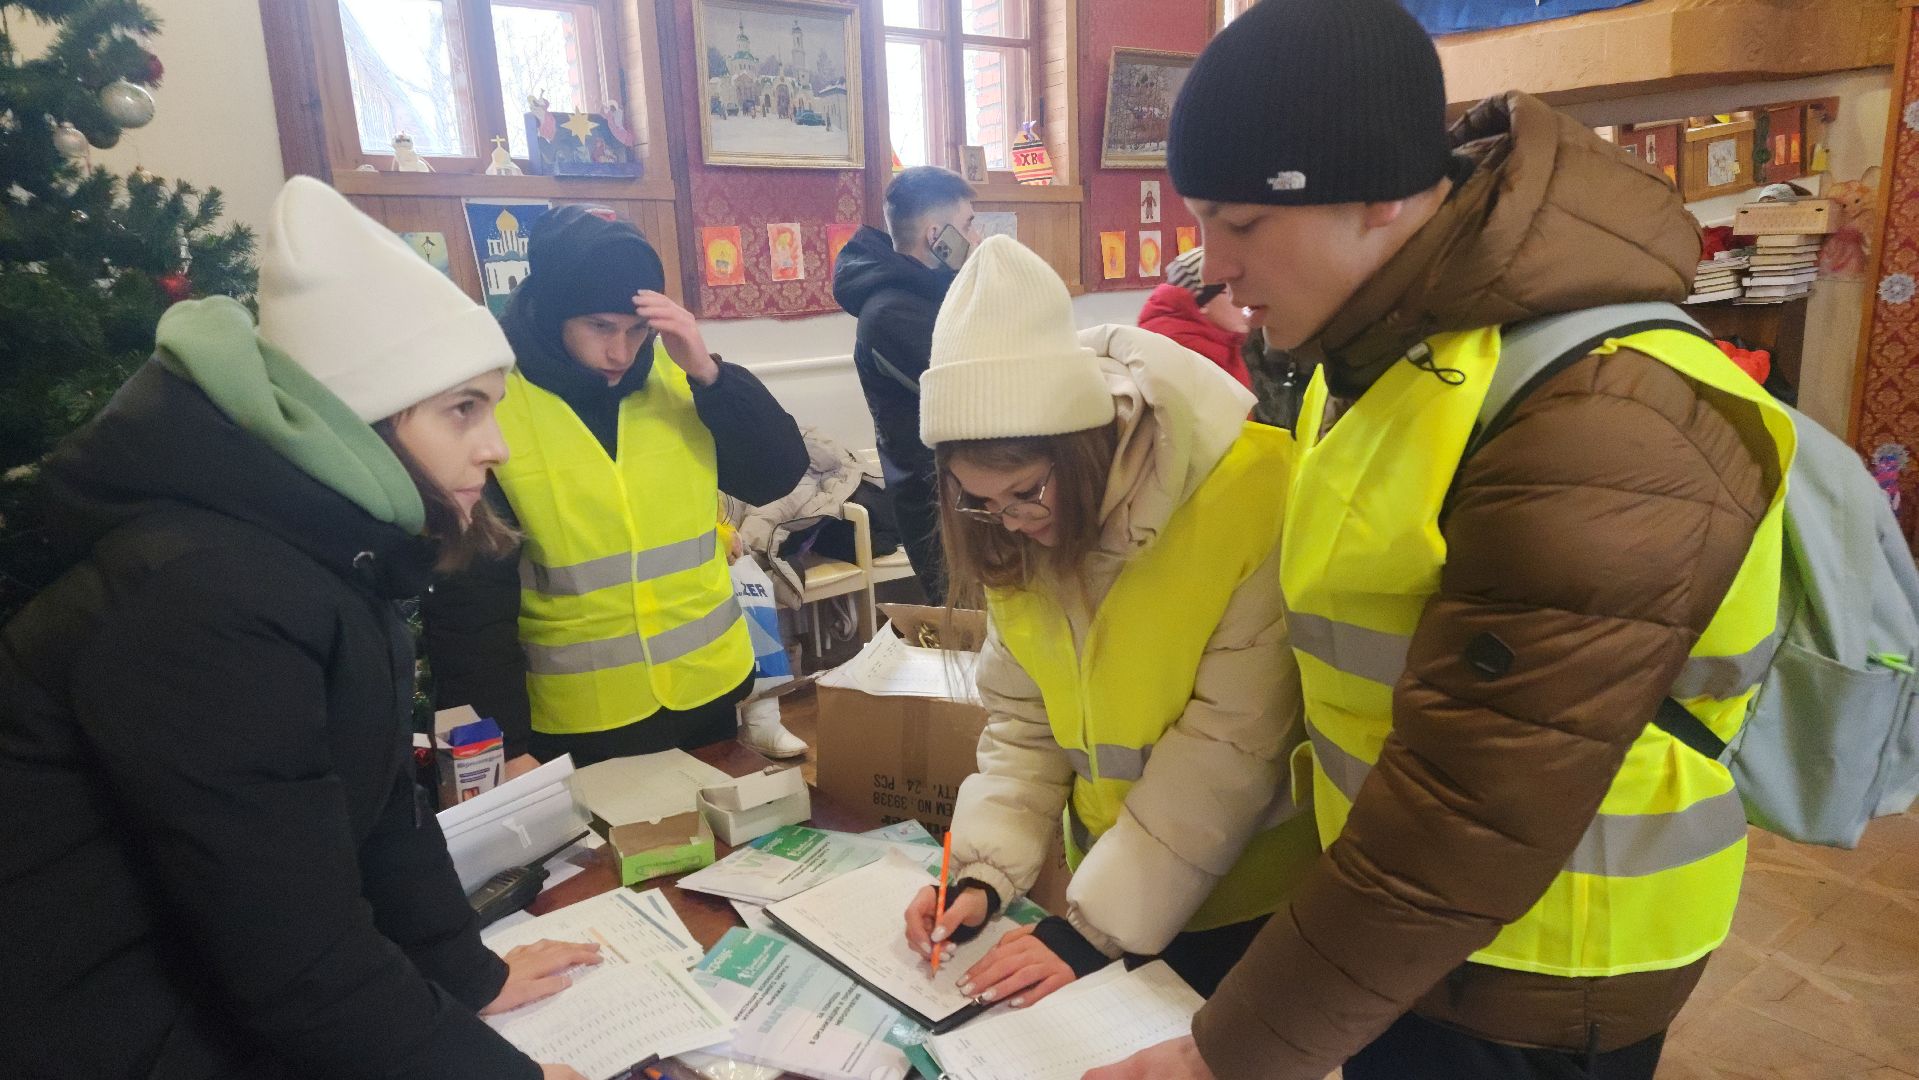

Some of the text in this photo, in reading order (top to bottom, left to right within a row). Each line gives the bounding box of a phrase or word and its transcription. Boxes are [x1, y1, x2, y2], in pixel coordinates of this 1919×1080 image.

[1020, 153, 1037, 166] ХВ
[873, 774, 895, 790] PCS
[907, 780, 922, 794] 24
[872, 791, 908, 811] 39338
[936, 801, 954, 817] EM
